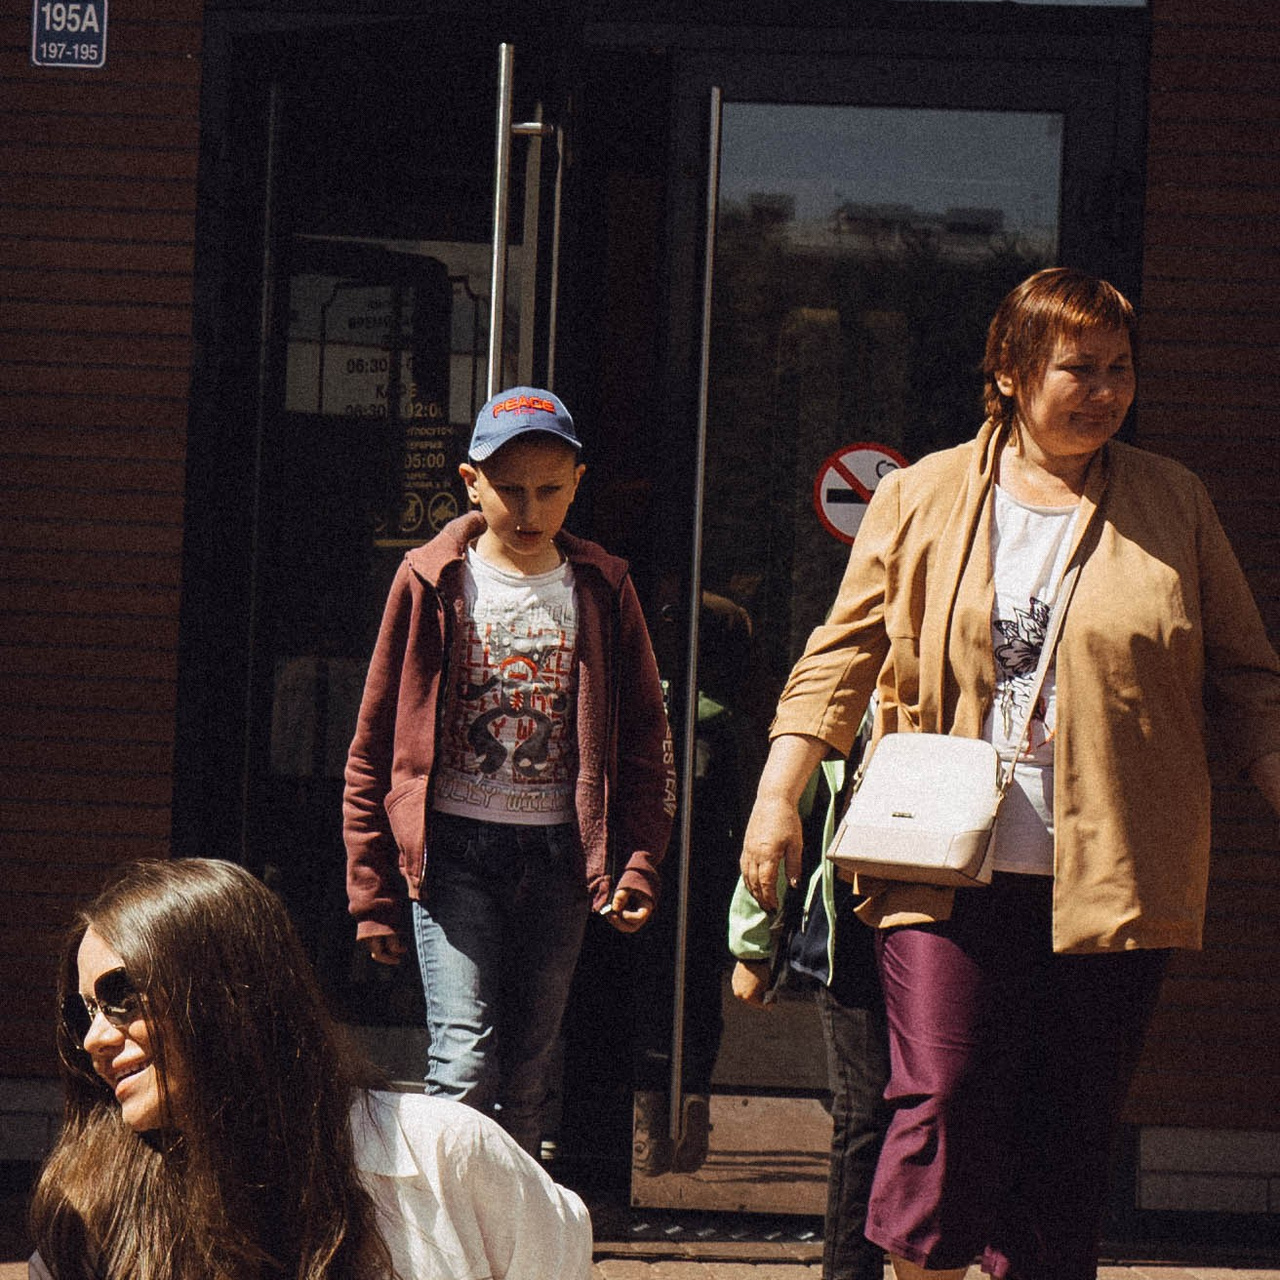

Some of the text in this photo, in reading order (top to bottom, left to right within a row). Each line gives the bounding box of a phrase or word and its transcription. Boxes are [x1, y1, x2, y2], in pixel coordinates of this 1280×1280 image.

[41, 2, 100, 33] 195А
[40, 43, 98, 61] 197-195
[492, 394, 557, 418] PEACE
